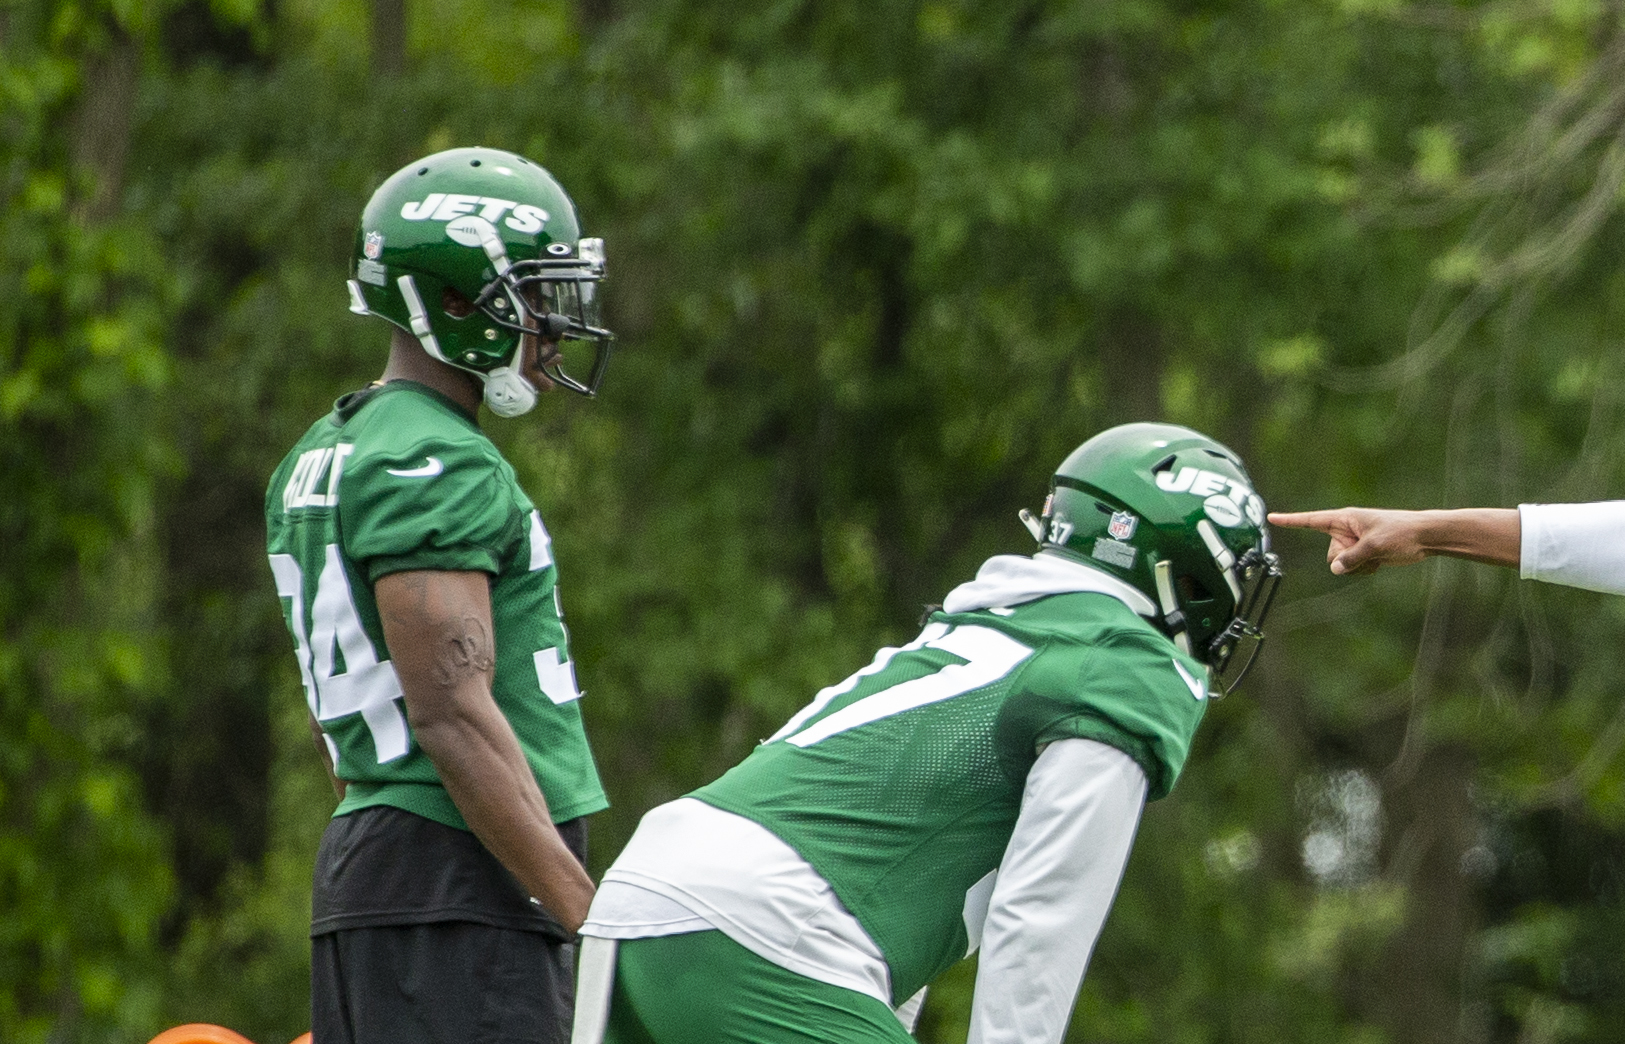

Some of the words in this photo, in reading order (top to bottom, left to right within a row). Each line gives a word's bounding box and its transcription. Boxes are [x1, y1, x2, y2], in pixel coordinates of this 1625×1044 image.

[401, 193, 549, 234] JETS
[1155, 467, 1265, 527] JETS
[1048, 520, 1074, 546] 37
[1110, 522, 1131, 538] NFL
